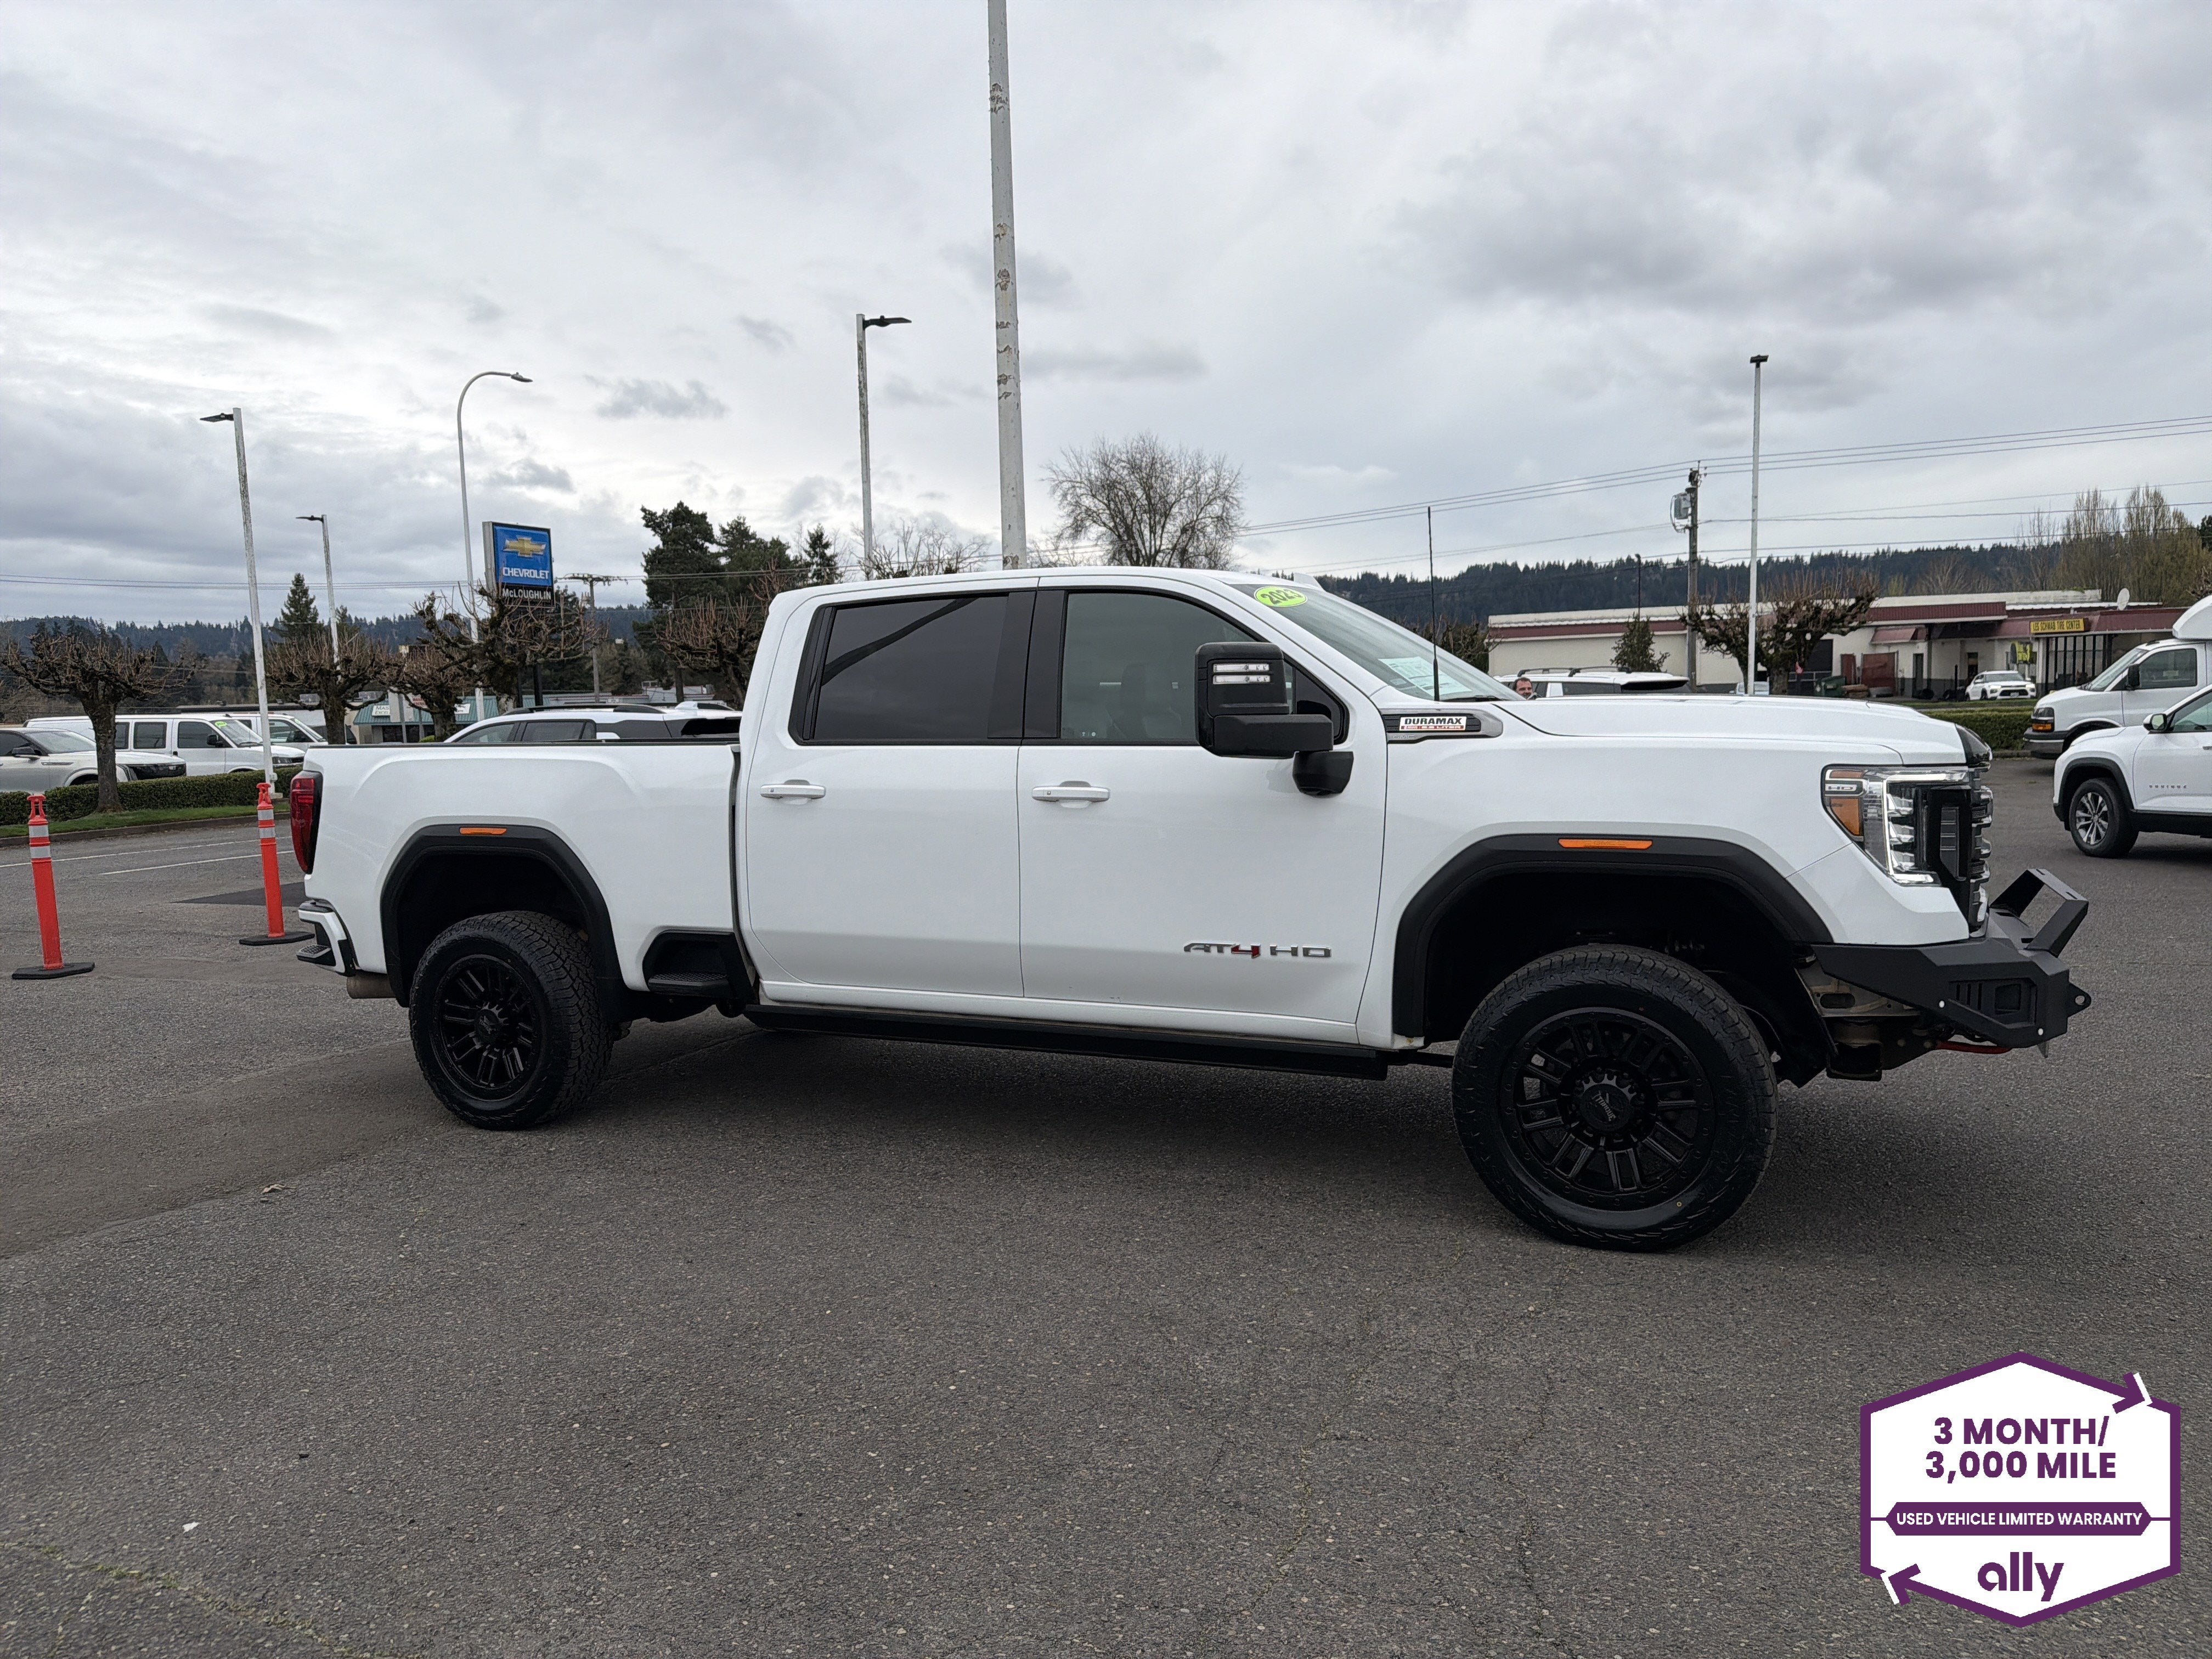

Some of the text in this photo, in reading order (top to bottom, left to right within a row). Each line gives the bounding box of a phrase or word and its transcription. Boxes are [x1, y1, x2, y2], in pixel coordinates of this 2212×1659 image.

[503, 567, 549, 579] CHEVROLET
[502, 588, 551, 600] McLOUGHLIN
[1261, 589, 1303, 605] 2023
[1183, 940, 1332, 959] AT4 HD
